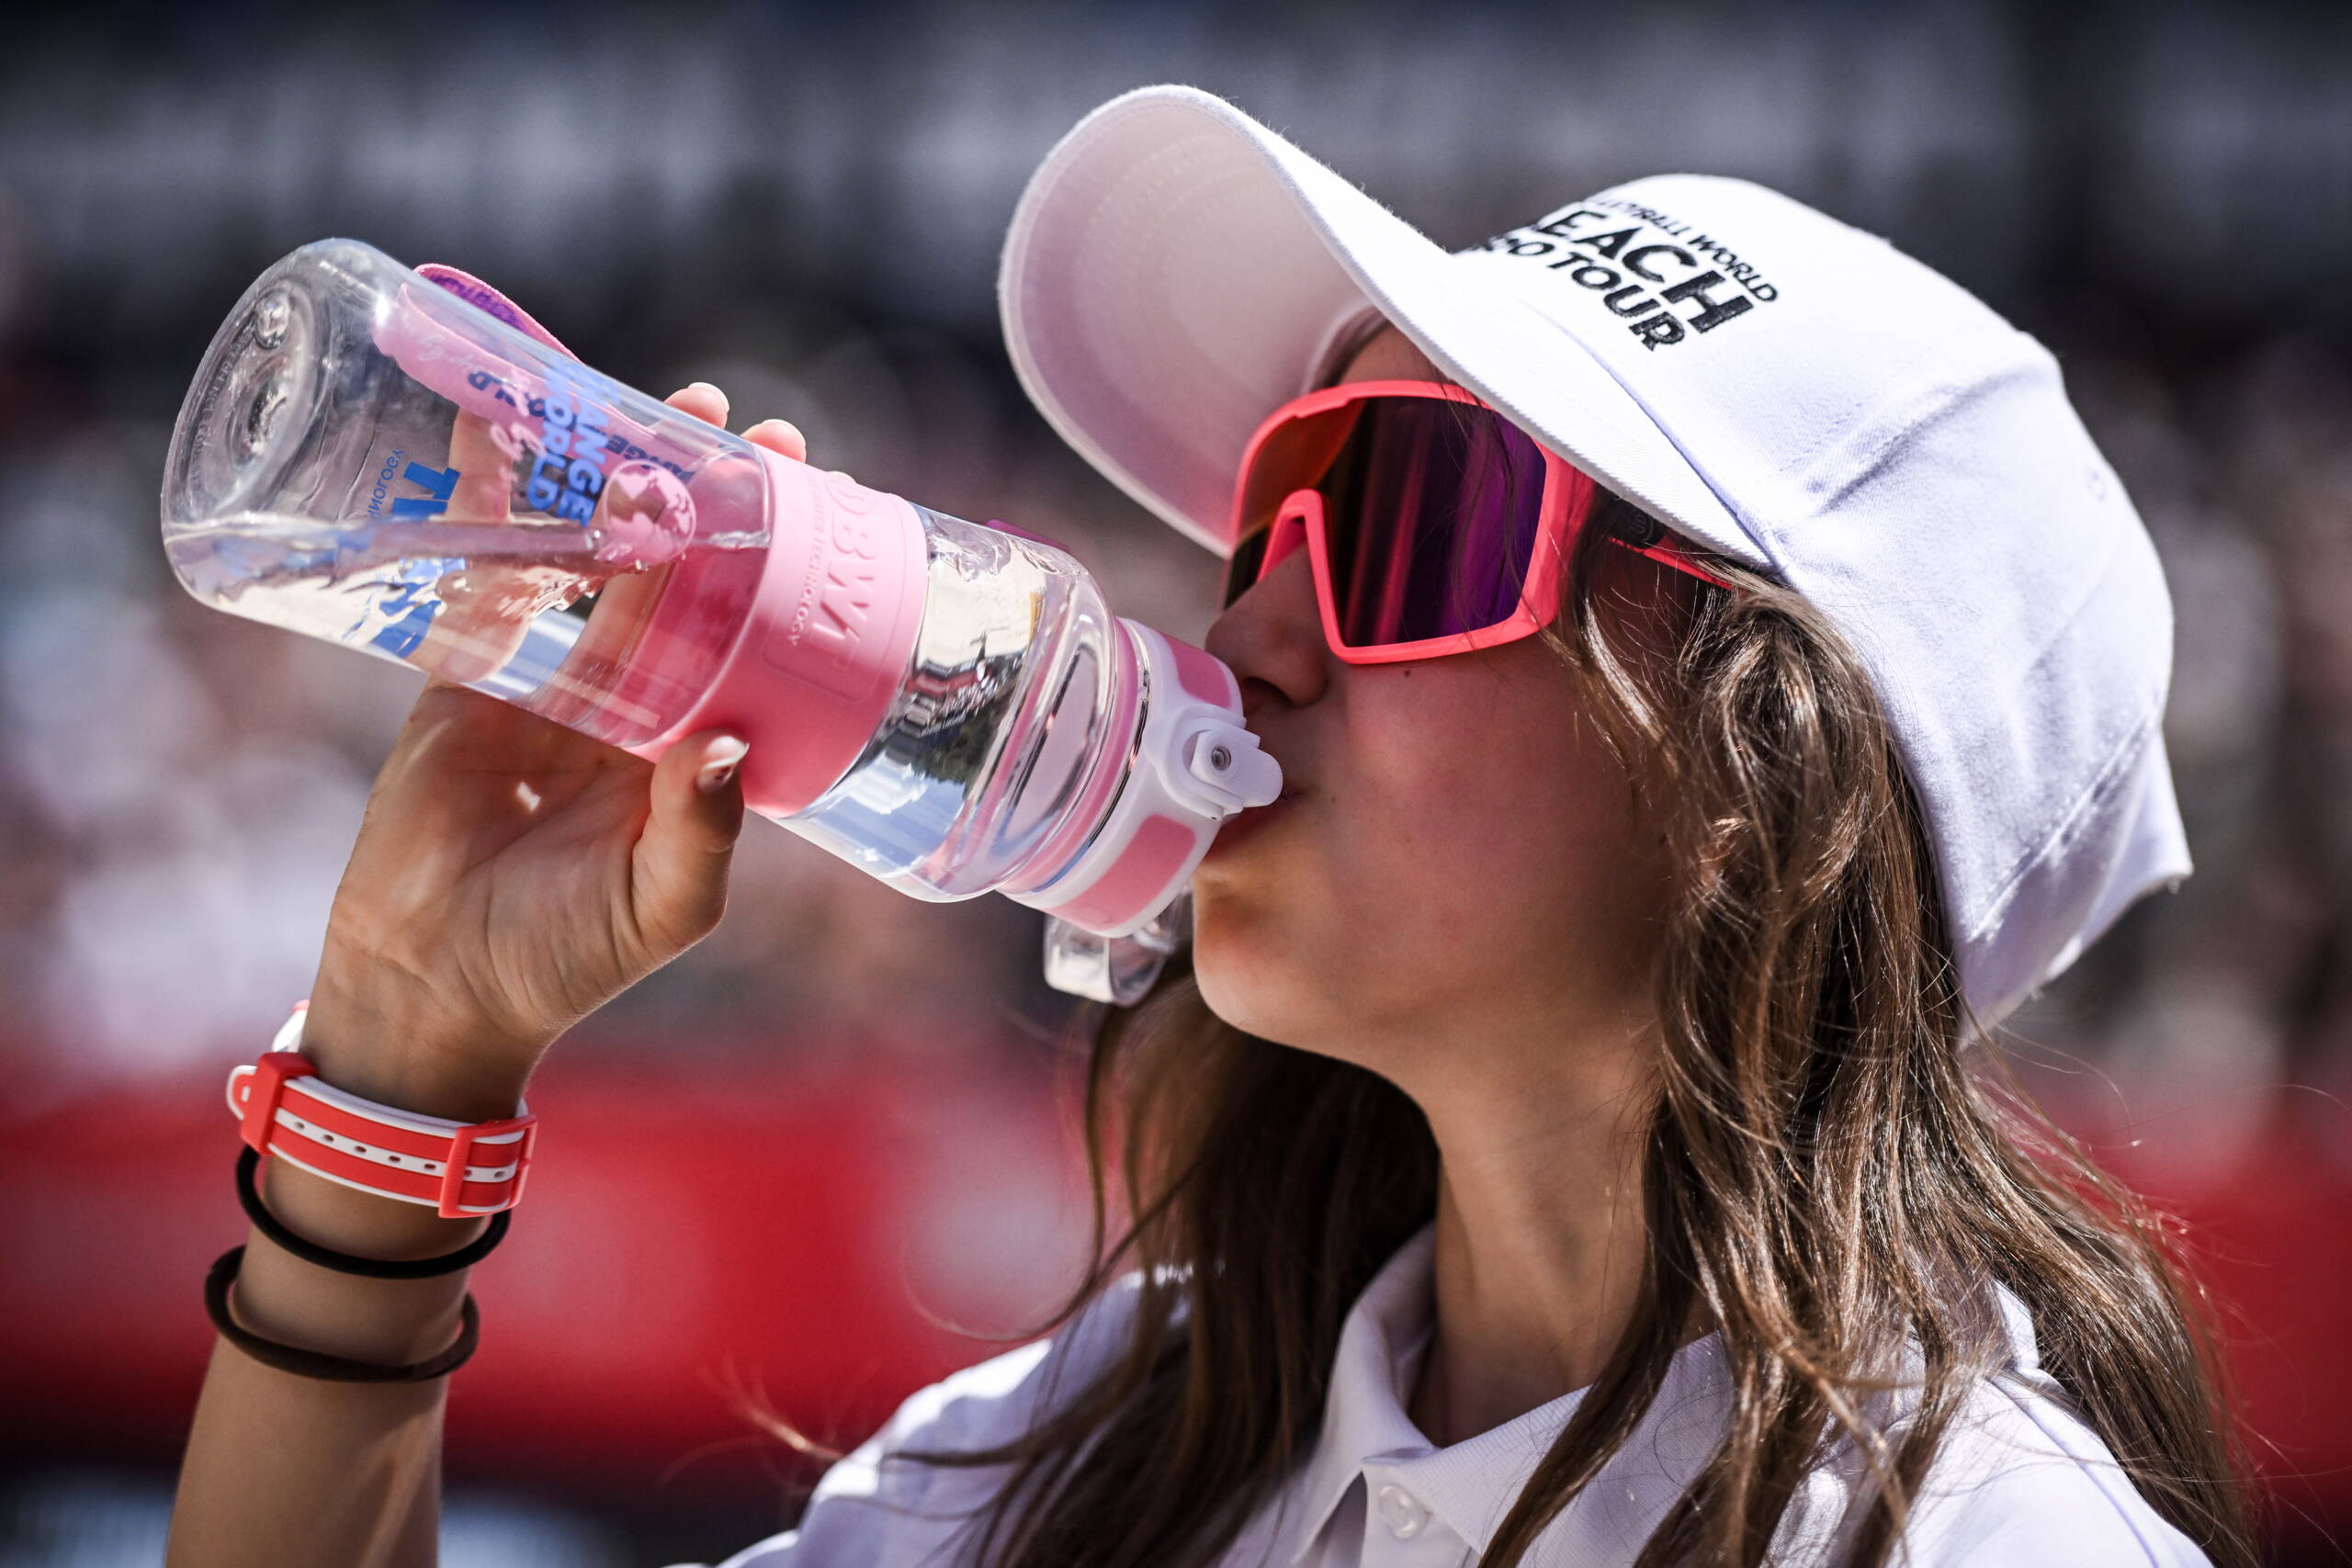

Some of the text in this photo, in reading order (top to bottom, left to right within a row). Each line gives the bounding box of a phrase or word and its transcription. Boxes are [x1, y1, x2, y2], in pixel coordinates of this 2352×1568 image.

[1535, 210, 1754, 333] EACH
[1546, 252, 1686, 352] TOUR
[1687, 235, 1778, 302] WORLD
[557, 367, 618, 527] ANGE
